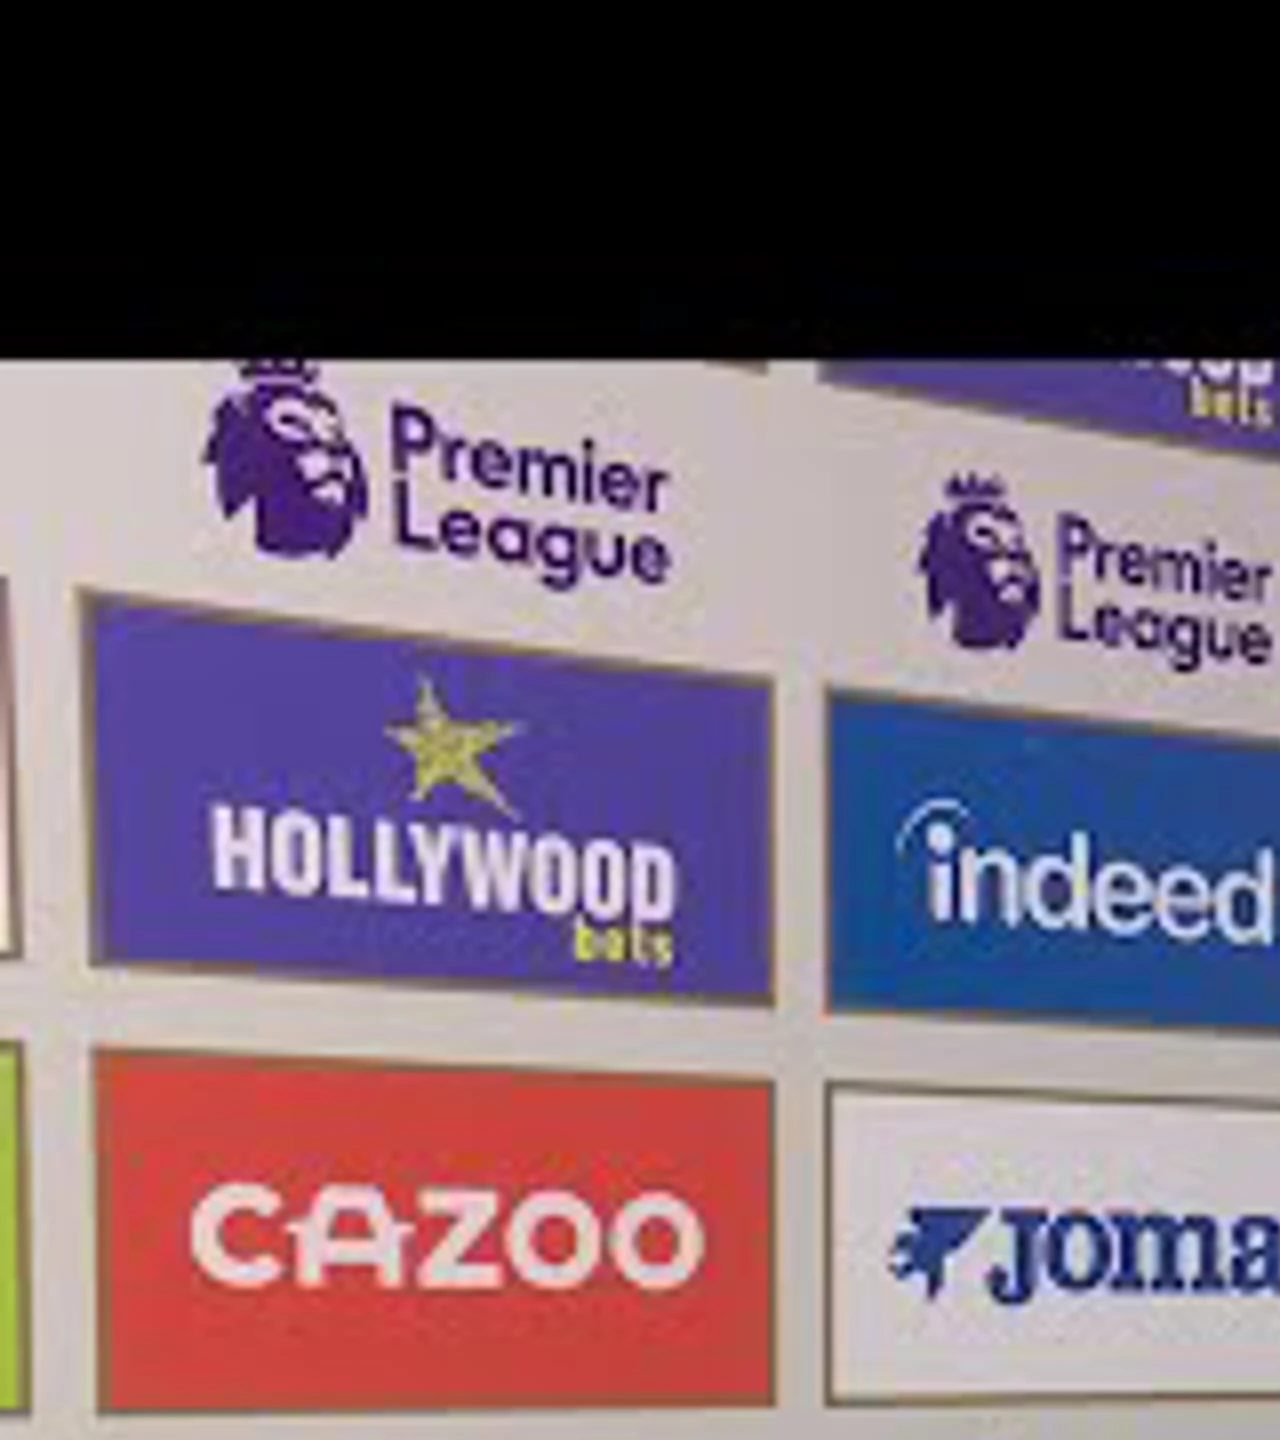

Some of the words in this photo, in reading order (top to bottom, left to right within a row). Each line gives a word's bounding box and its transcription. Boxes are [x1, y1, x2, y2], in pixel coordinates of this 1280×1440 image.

[389, 400, 672, 514] Premier
[389, 478, 674, 592] League
[1055, 512, 1273, 602] Premier
[1055, 585, 1275, 674] League
[211, 804, 676, 920] HOLLYWOOD
[926, 820, 1277, 946] indeed
[573, 913, 675, 967] bets
[190, 1182, 706, 1290] CAZOO
